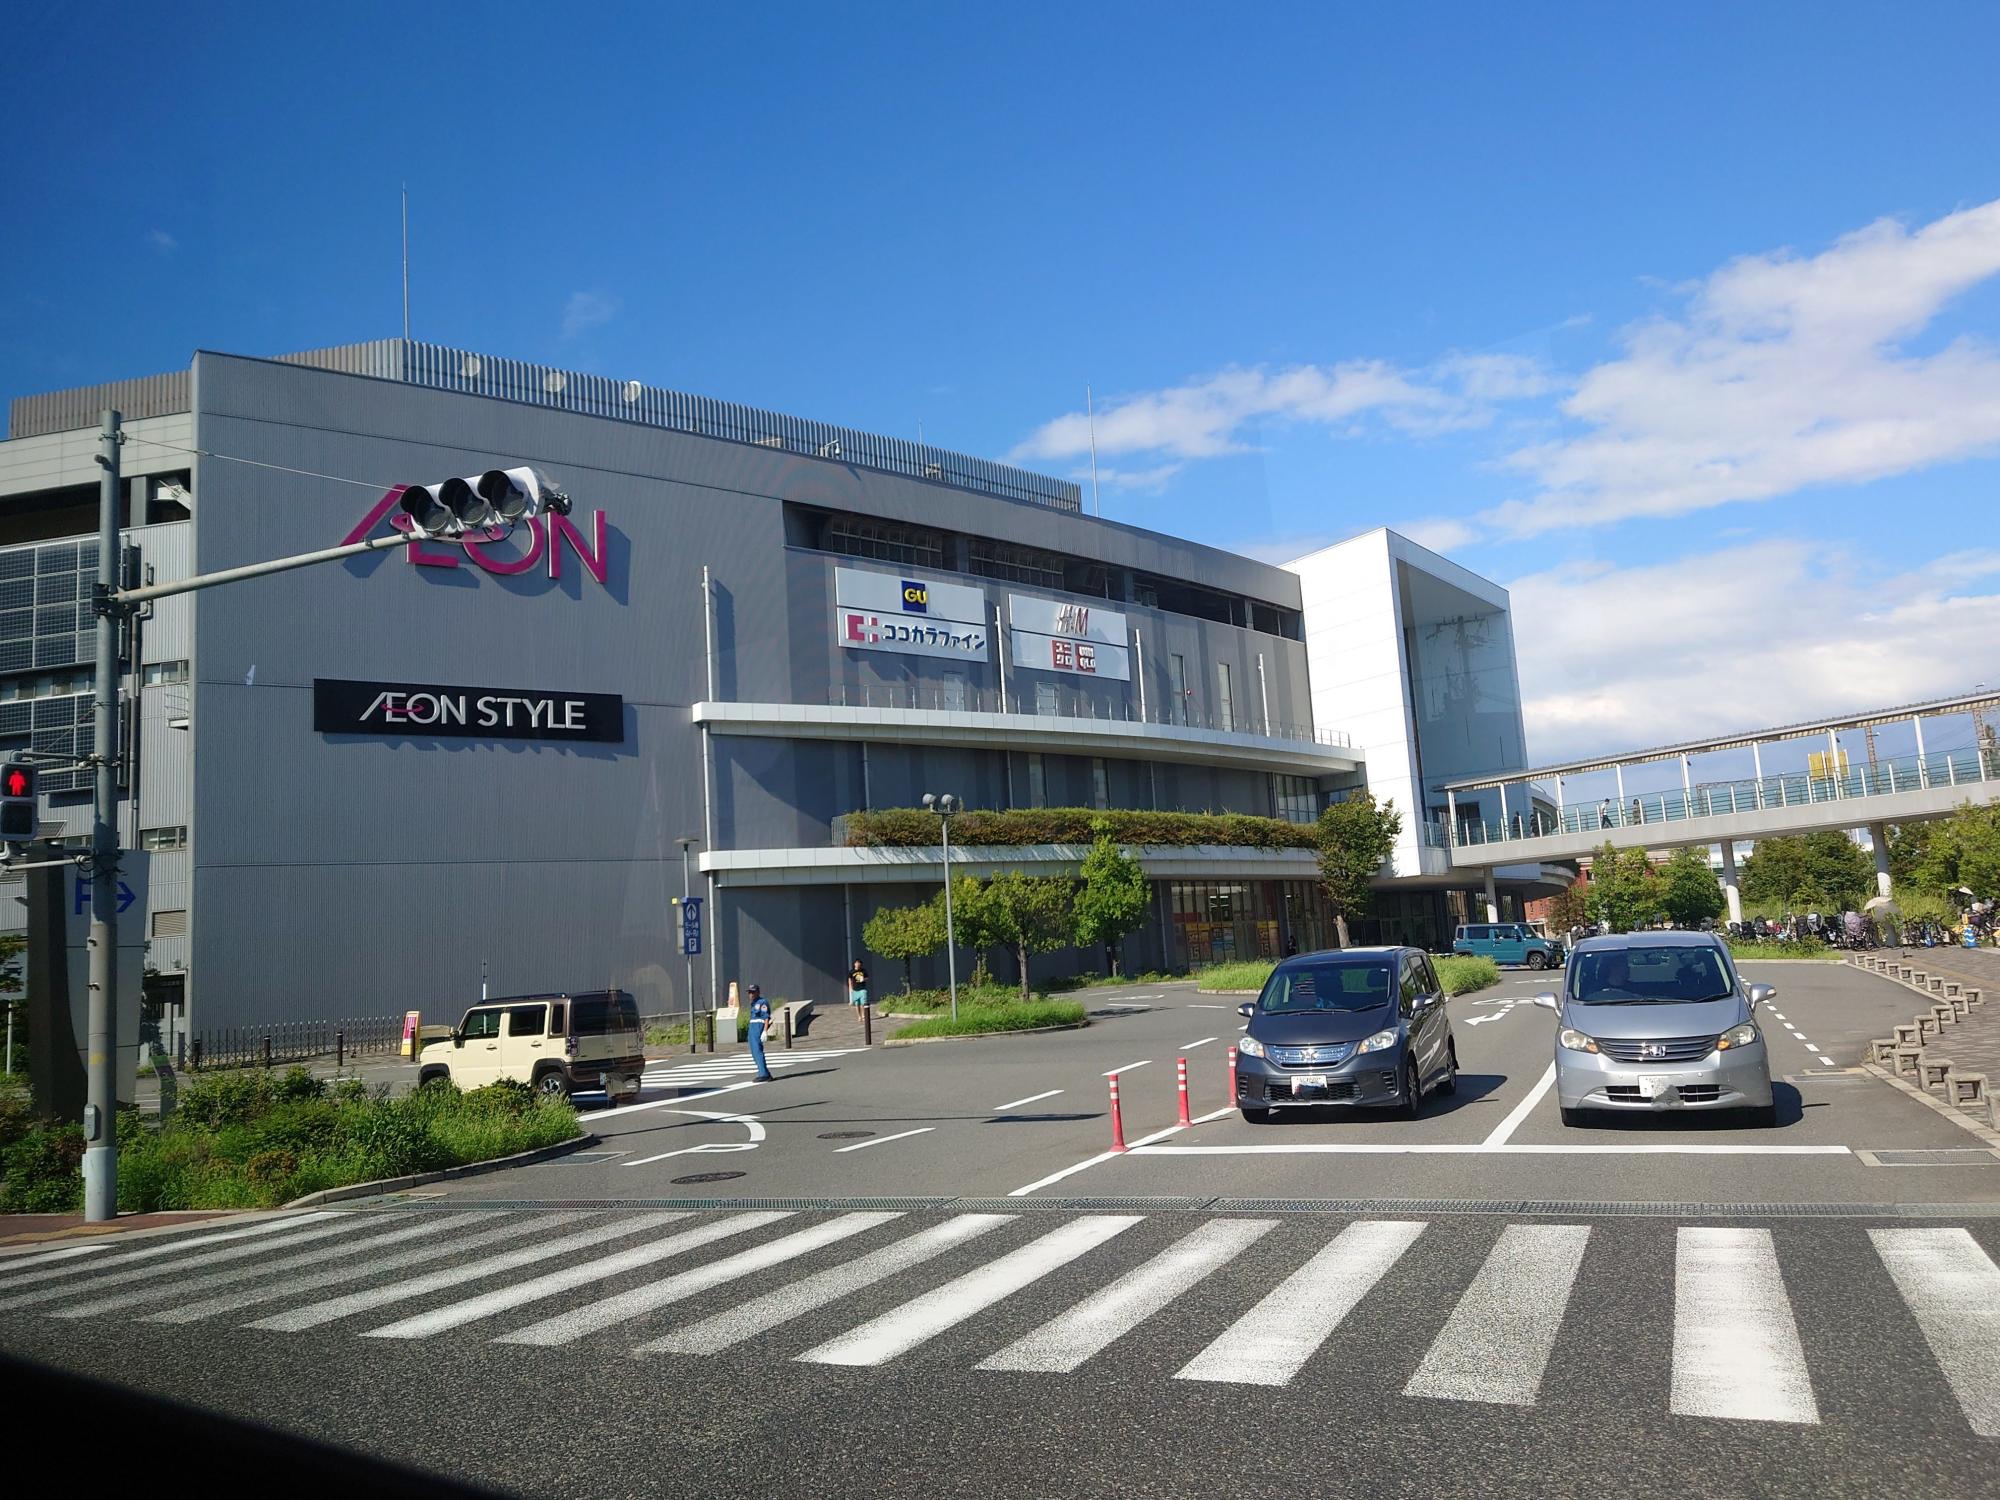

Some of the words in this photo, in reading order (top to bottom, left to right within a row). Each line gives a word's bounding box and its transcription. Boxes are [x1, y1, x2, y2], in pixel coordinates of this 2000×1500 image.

[904, 588, 928, 604] GU
[882, 623, 985, 650] ココカラファイン
[477, 696, 587, 730] STYLE
